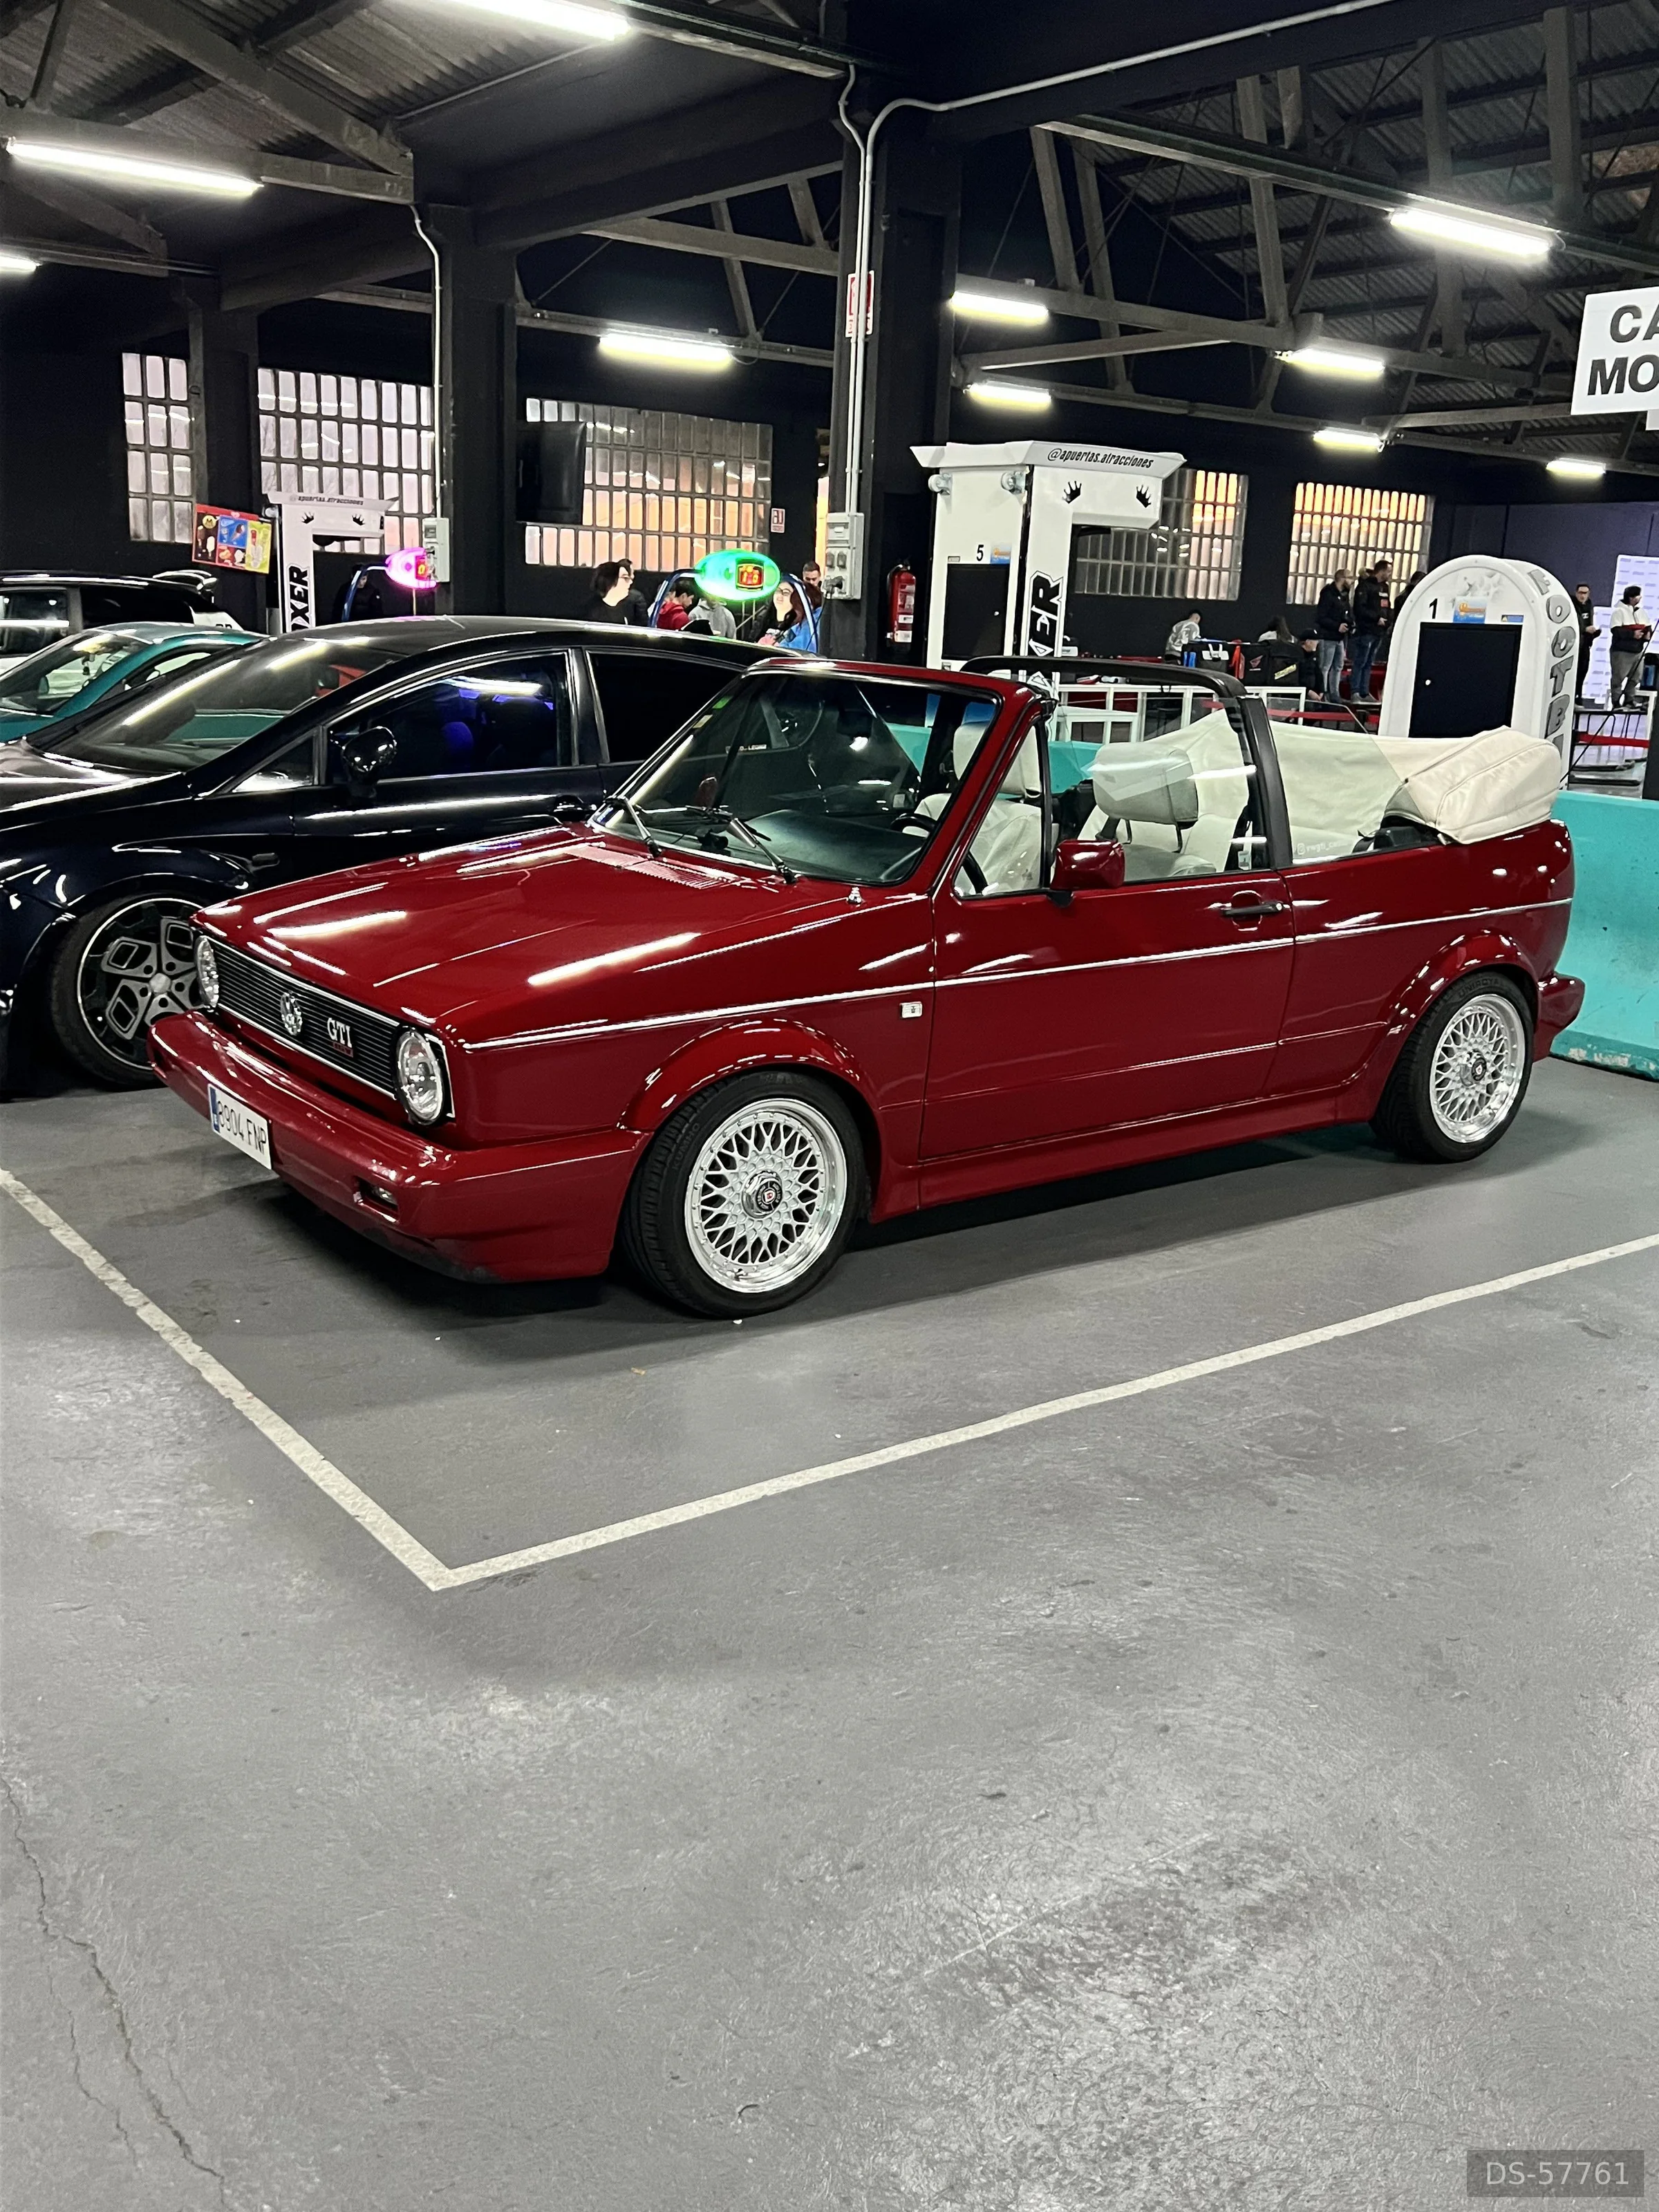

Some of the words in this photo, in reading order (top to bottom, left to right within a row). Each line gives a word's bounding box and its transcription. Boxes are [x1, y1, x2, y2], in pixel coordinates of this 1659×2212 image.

[1047, 448, 1154, 469] @apuertas.atracciones
[976, 543, 984, 561] 5
[1429, 598, 1438, 619] 1
[327, 1018, 352, 1048] GTI
